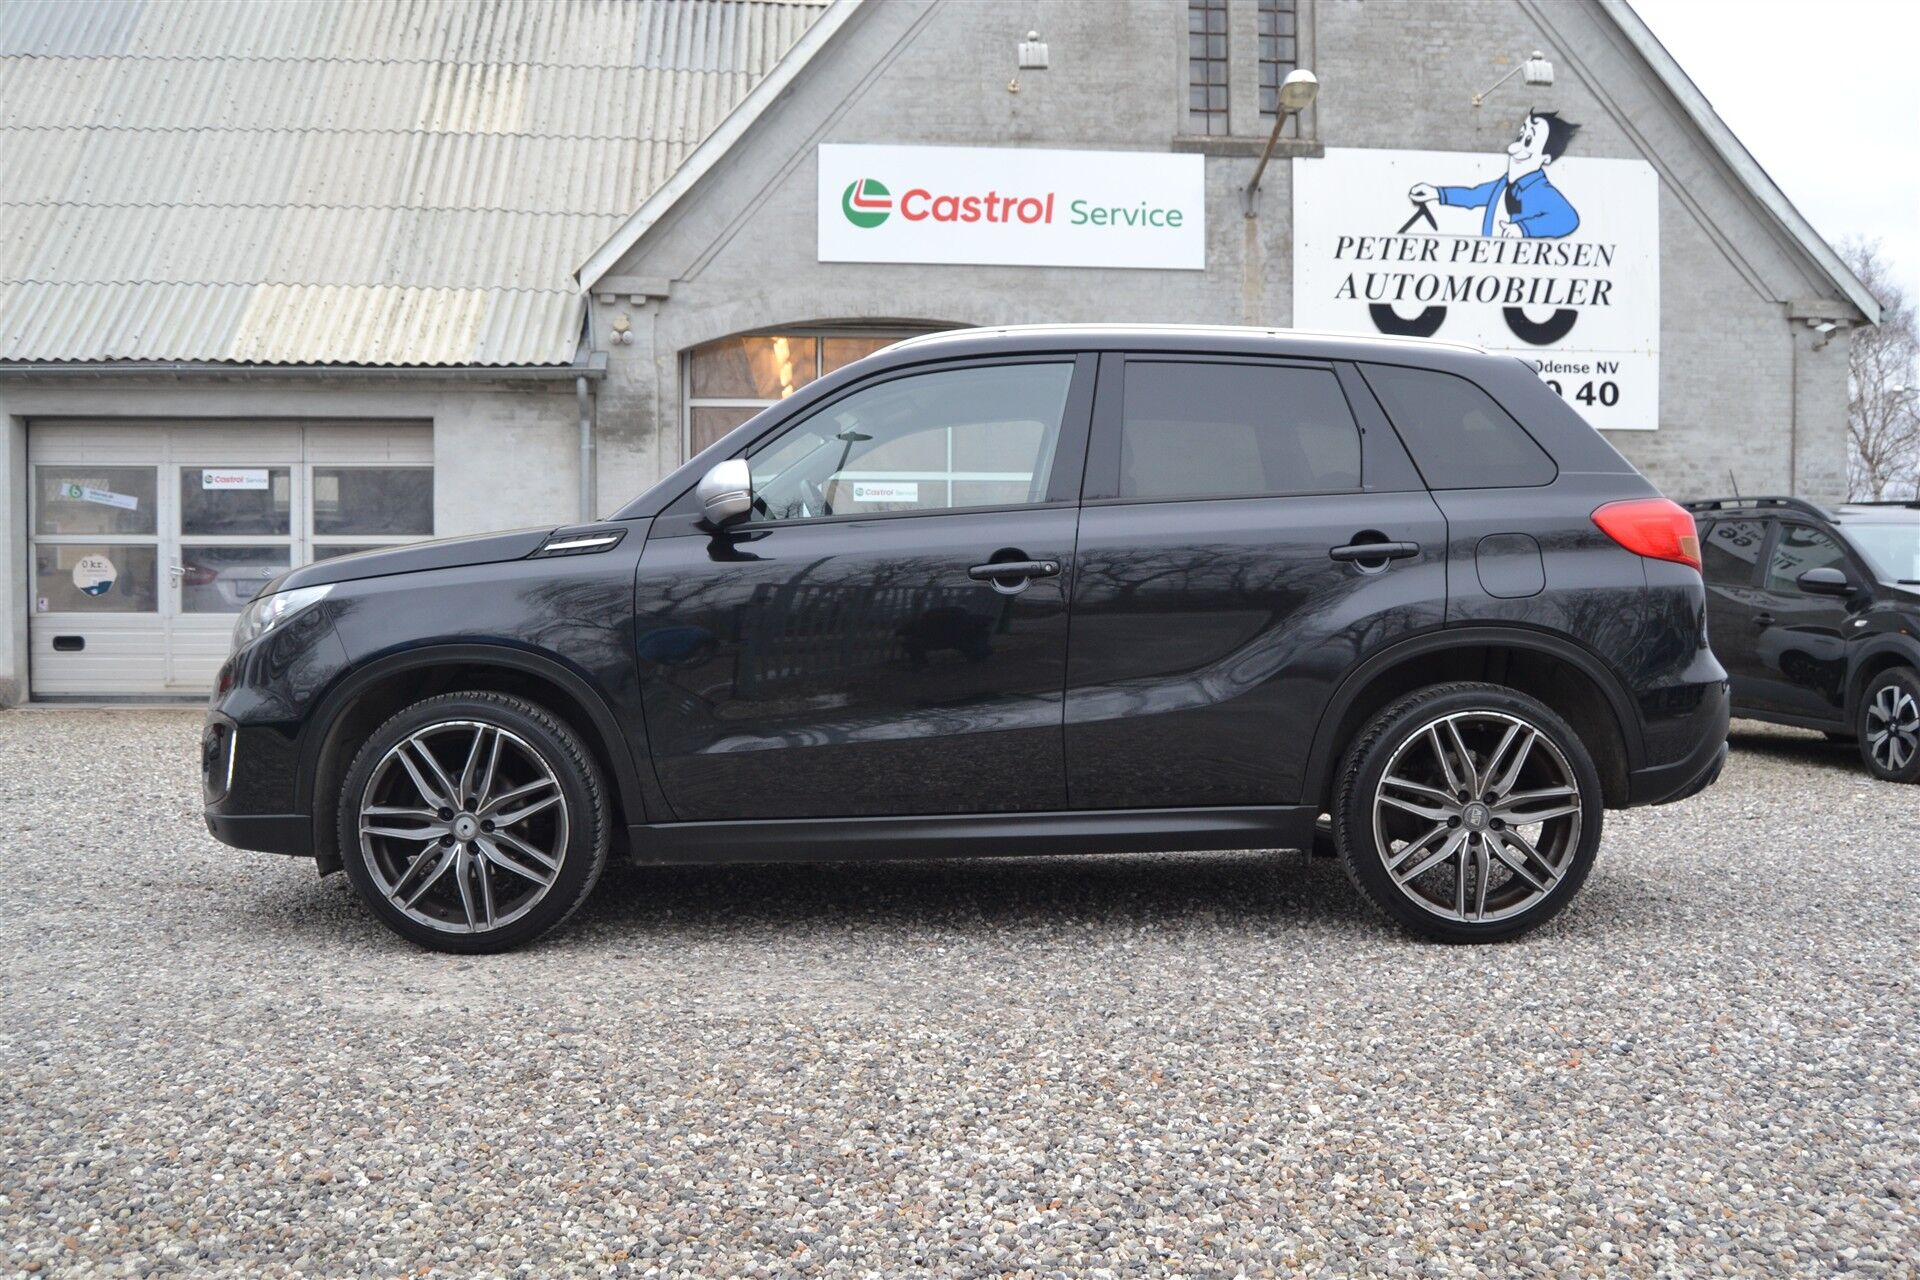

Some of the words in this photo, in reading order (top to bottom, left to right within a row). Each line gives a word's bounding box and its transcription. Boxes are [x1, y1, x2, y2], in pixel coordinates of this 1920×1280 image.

[900, 189, 1055, 224] Castrol
[1070, 200, 1183, 227] Service
[1334, 235, 1440, 262] PETER
[1449, 238, 1616, 267] PETERSEN
[1334, 272, 1613, 306] AUTOMOBILER
[1597, 361, 1619, 374] NV
[1575, 381, 1619, 407] 40
[214, 475, 244, 484] Castrol
[865, 487, 895, 497] Castrol
